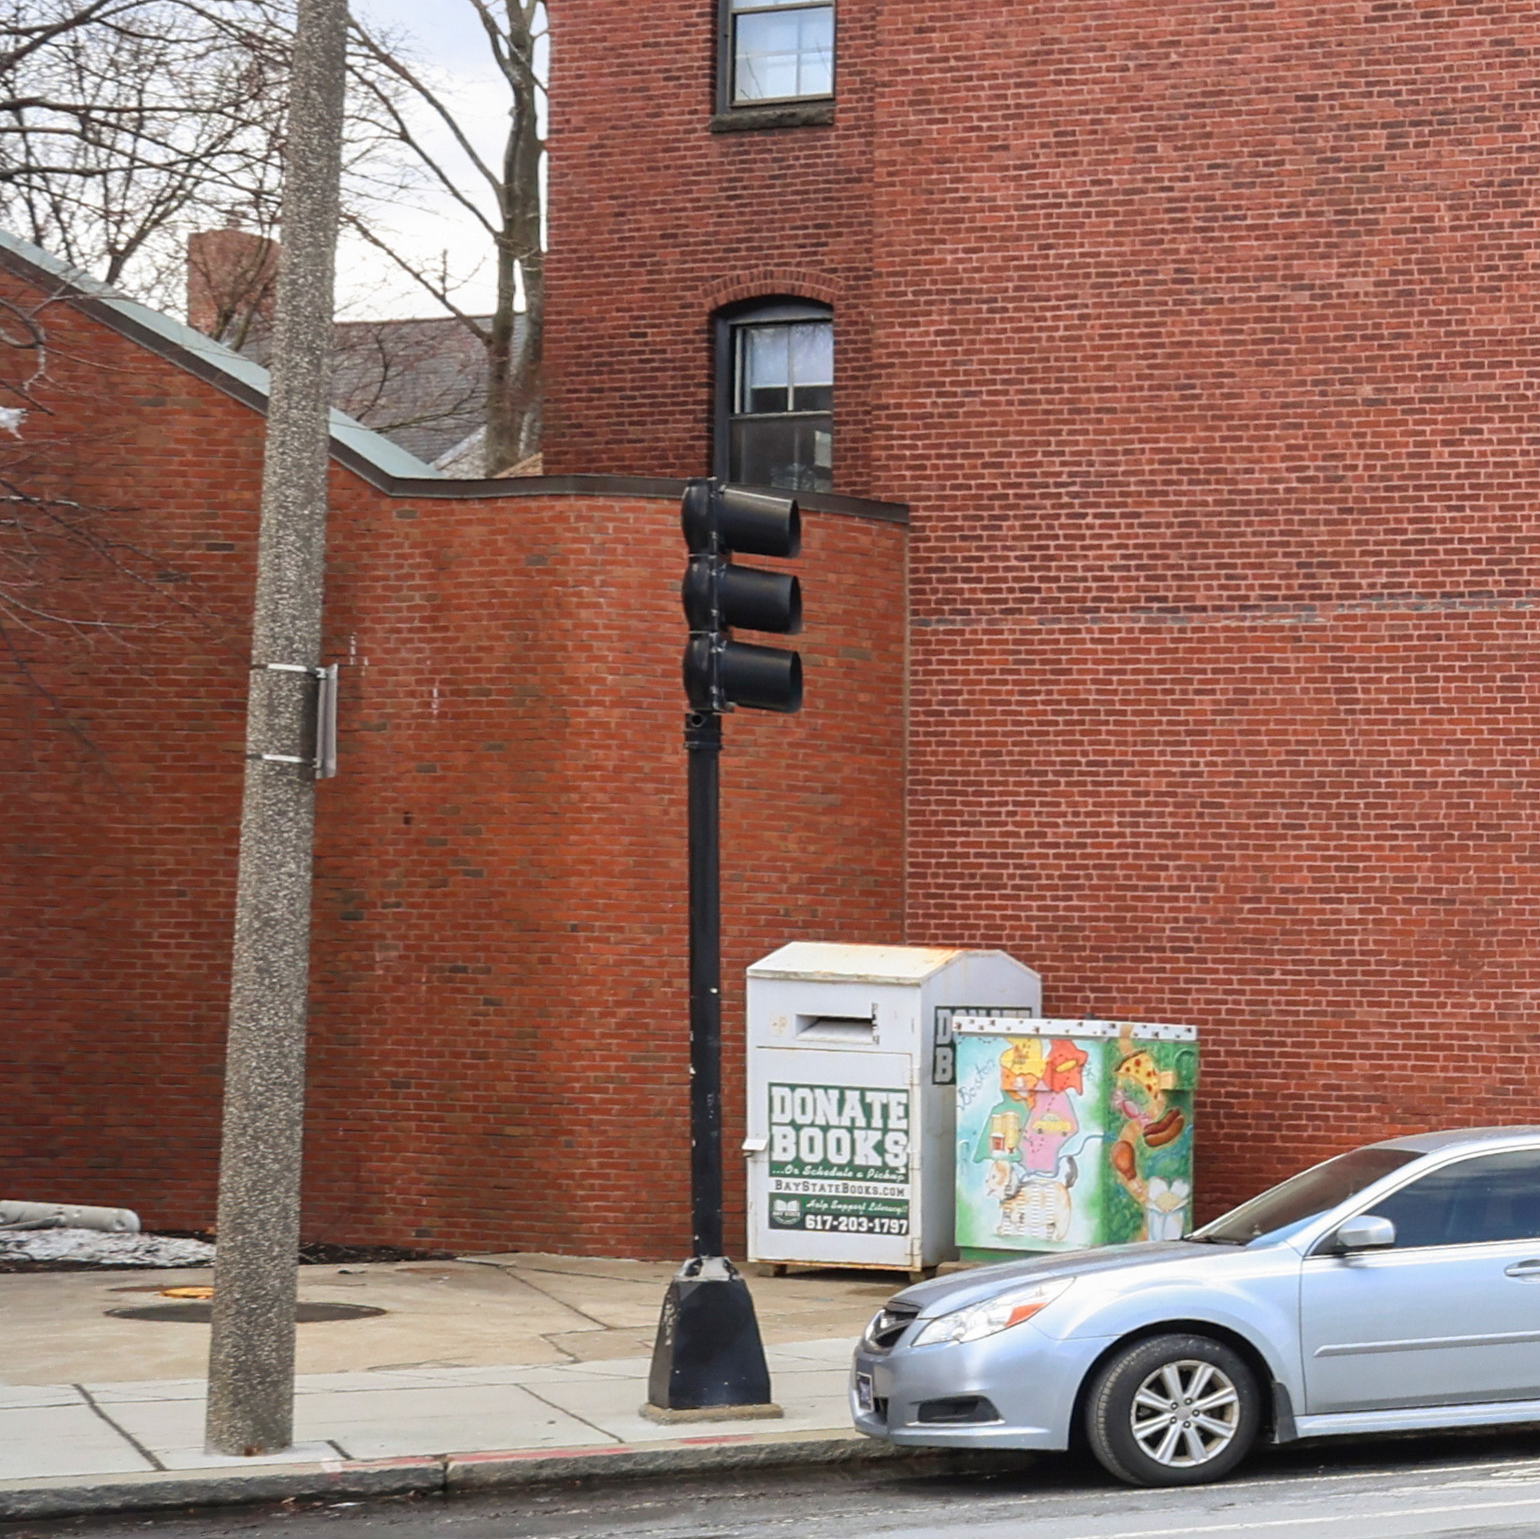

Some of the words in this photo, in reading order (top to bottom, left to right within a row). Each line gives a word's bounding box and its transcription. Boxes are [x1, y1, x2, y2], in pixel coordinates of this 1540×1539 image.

[771, 1086, 908, 1130] DONATE
[771, 1125, 908, 1168] BOOKS
[802, 1165, 853, 1178] Schedule
[856, 1171, 864, 1179] a
[867, 1168, 905, 1182] Pickup
[806, 1199, 829, 1212] Help
[831, 1199, 867, 1214] Support
[805, 1214, 908, 1235] 617-203-1797
